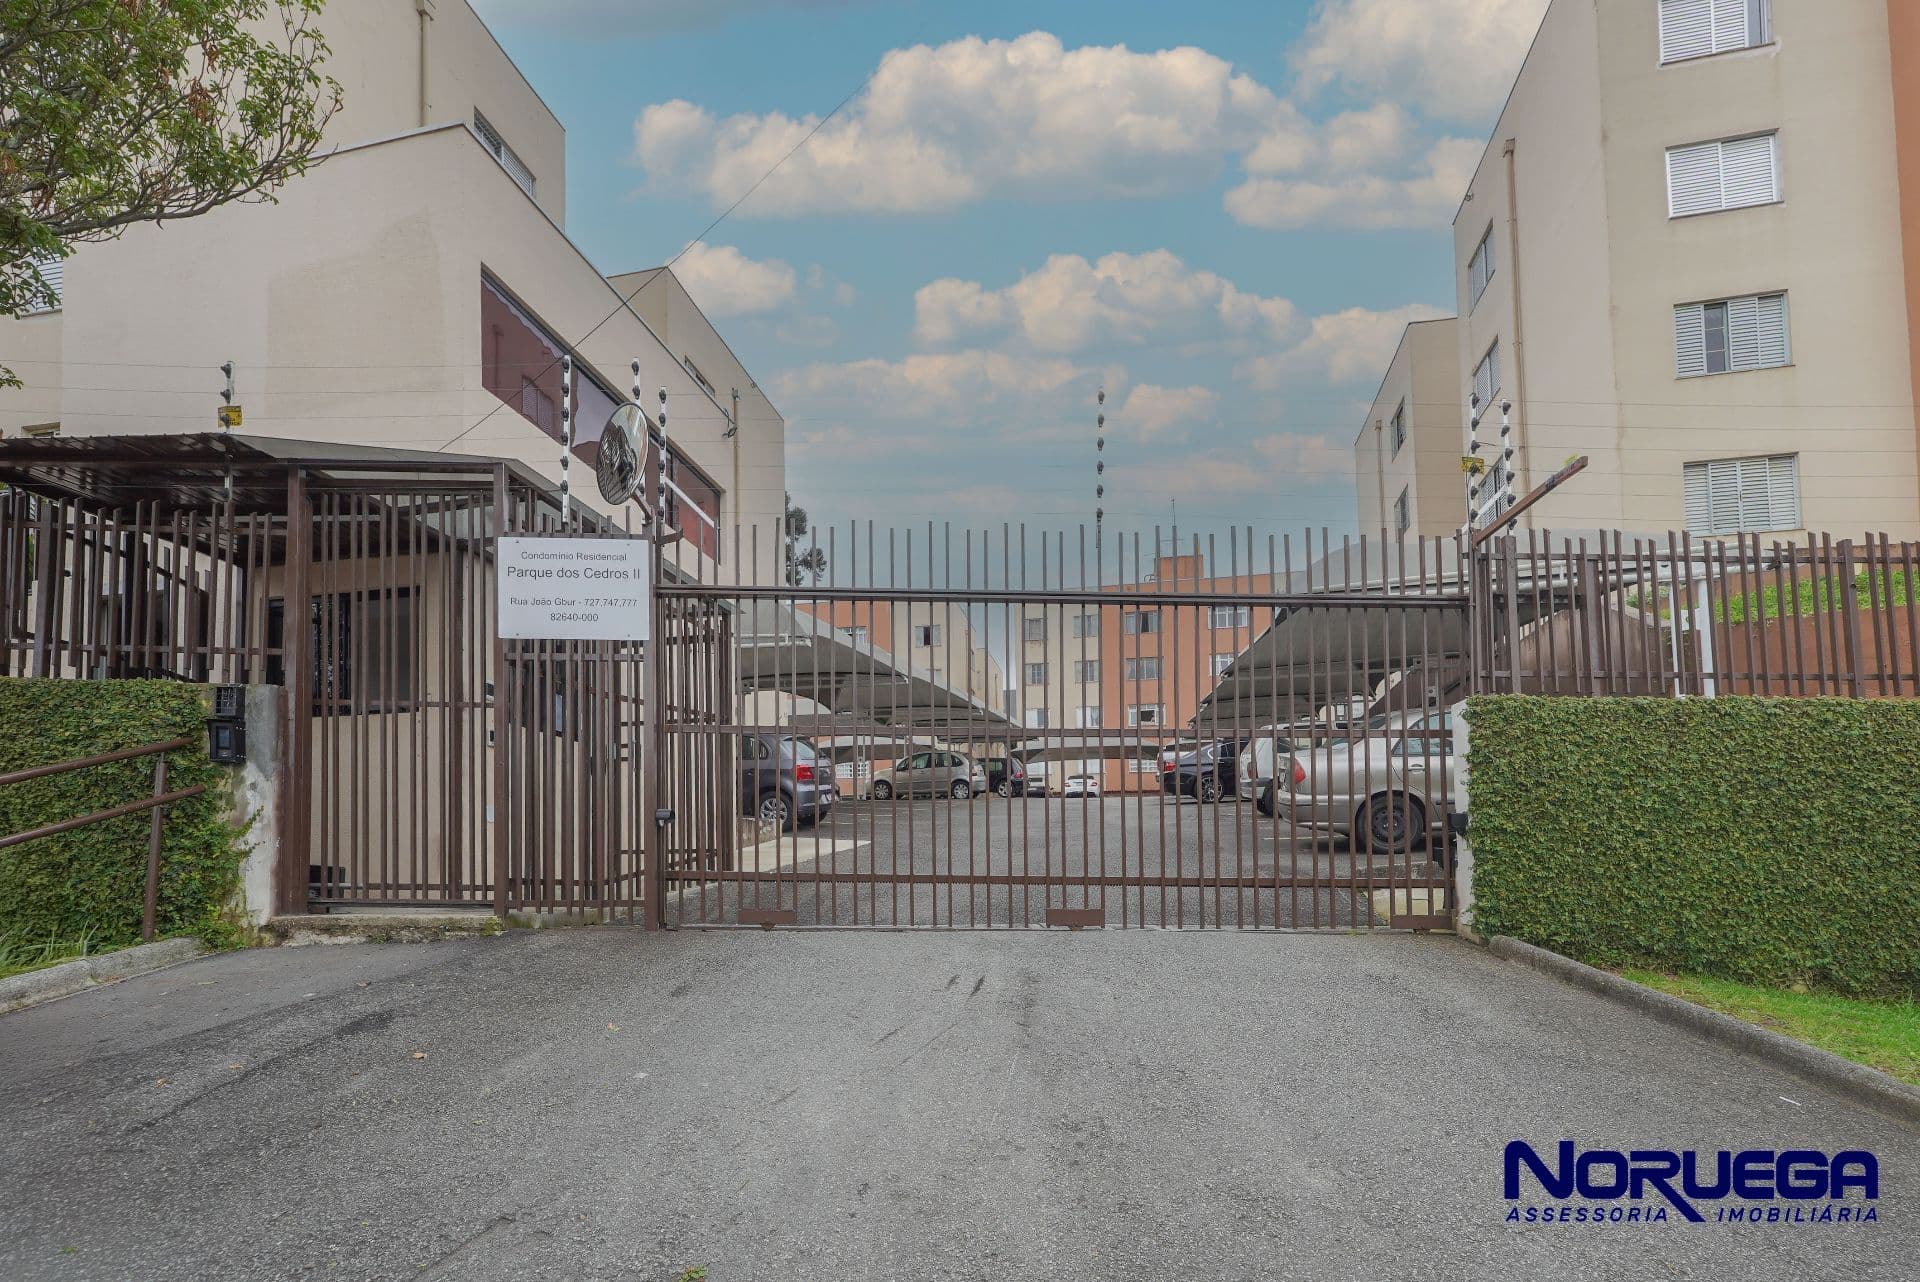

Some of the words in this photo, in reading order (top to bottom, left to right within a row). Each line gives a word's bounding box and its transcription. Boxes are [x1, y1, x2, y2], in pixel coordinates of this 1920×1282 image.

[576, 552, 627, 561] Residencial
[507, 566, 553, 580] Parque
[556, 567, 580, 578] dos
[584, 568, 629, 579] Cedros
[633, 568, 641, 580] II
[510, 597, 528, 606] Rua
[530, 597, 552, 606] João
[554, 598, 576, 606] Gbur
[550, 612, 600, 622] 82640-000
